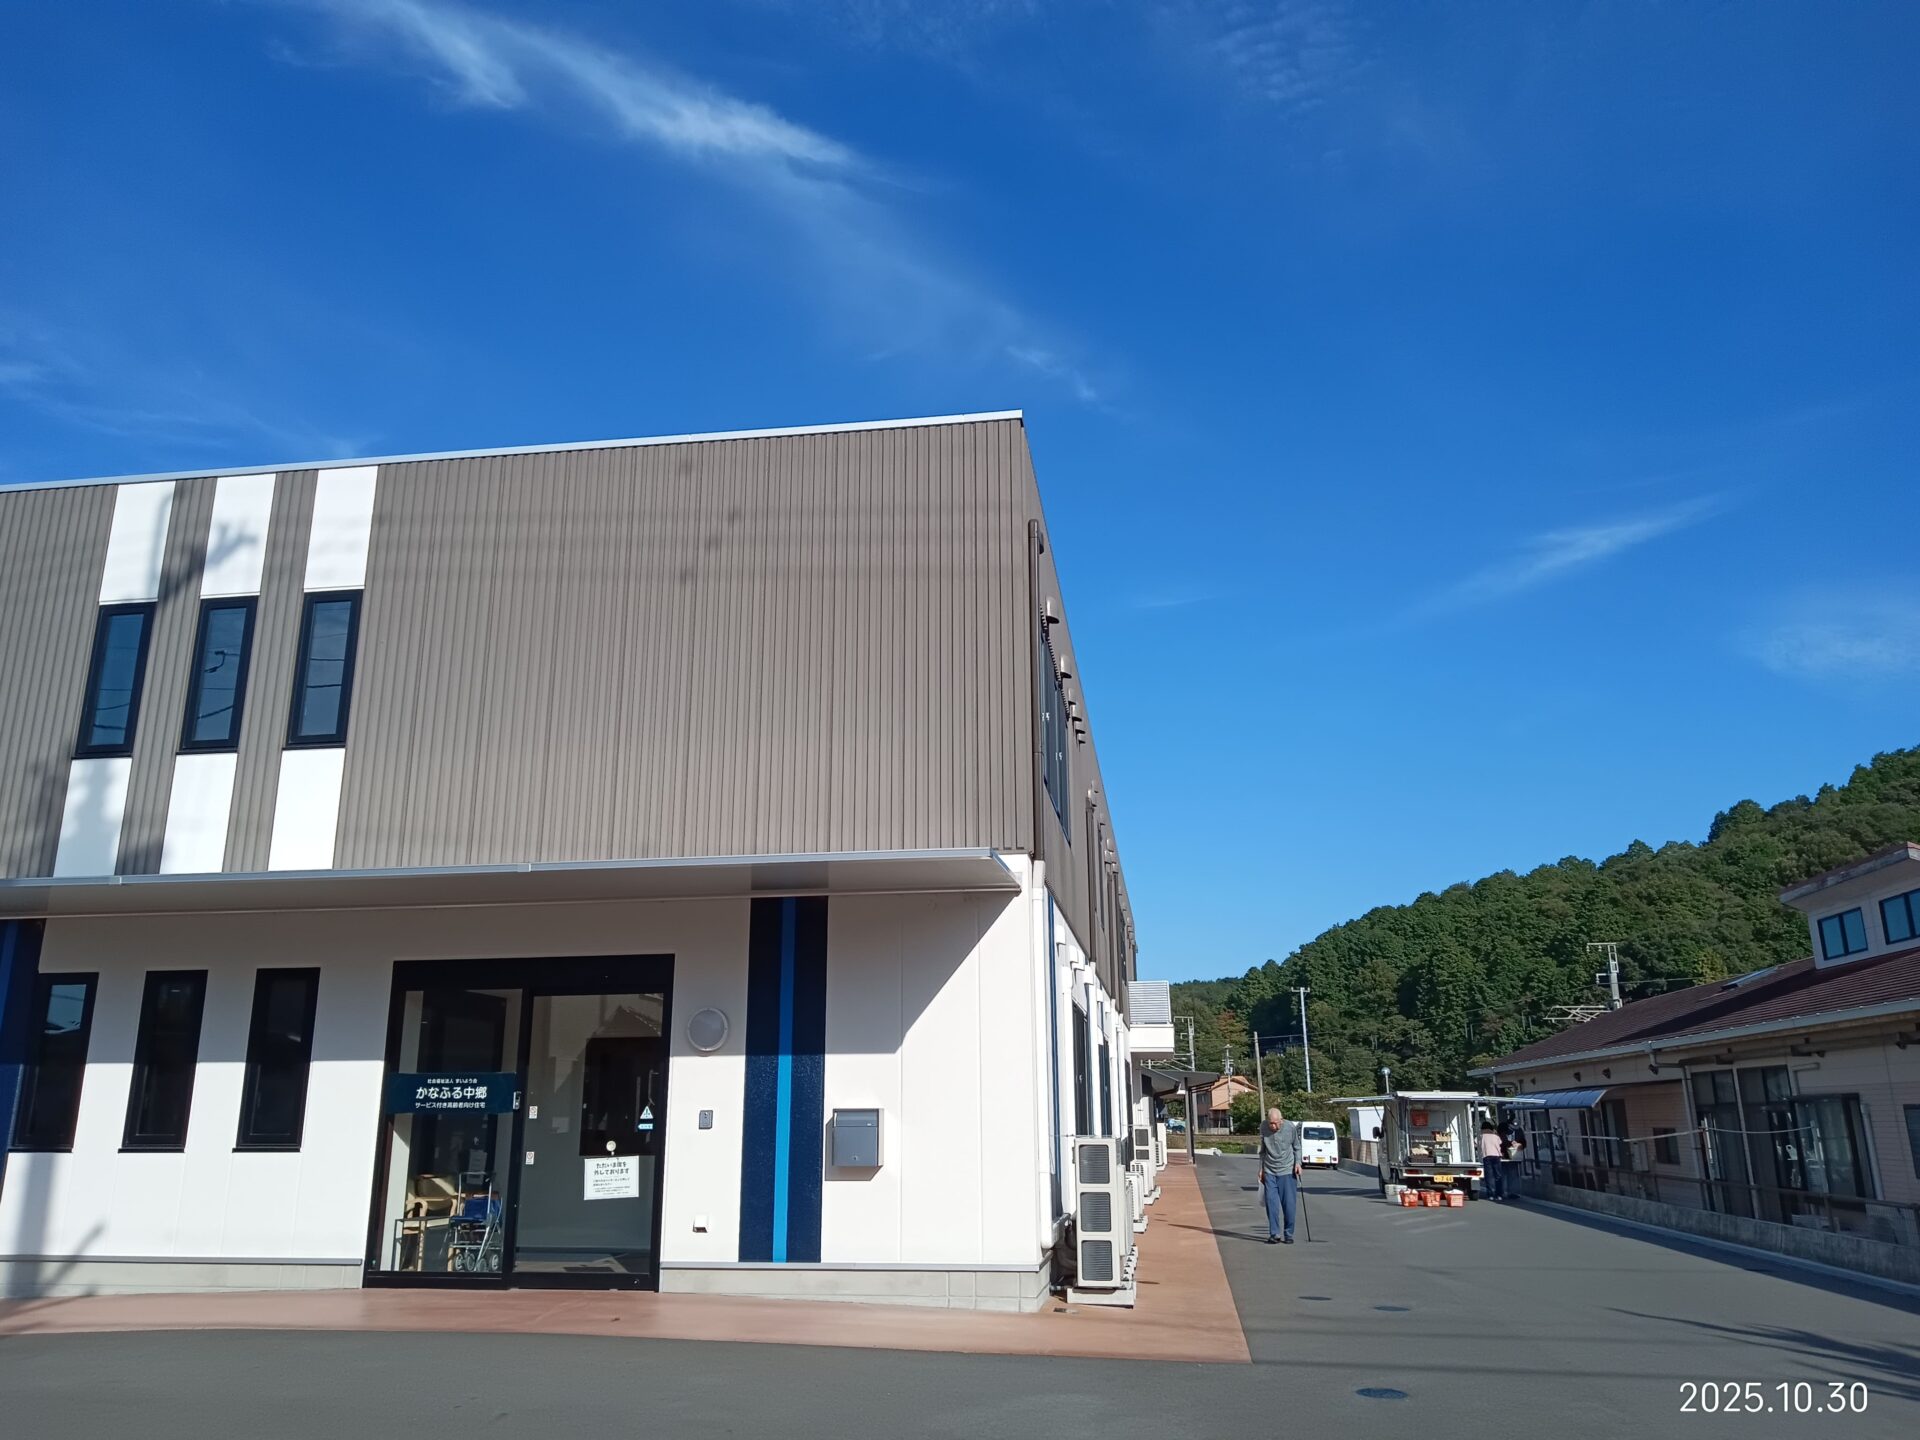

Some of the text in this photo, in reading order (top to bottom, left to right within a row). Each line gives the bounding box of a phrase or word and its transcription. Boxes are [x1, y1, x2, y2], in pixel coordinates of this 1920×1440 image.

[415, 1086, 488, 1099] かなふる中郷
